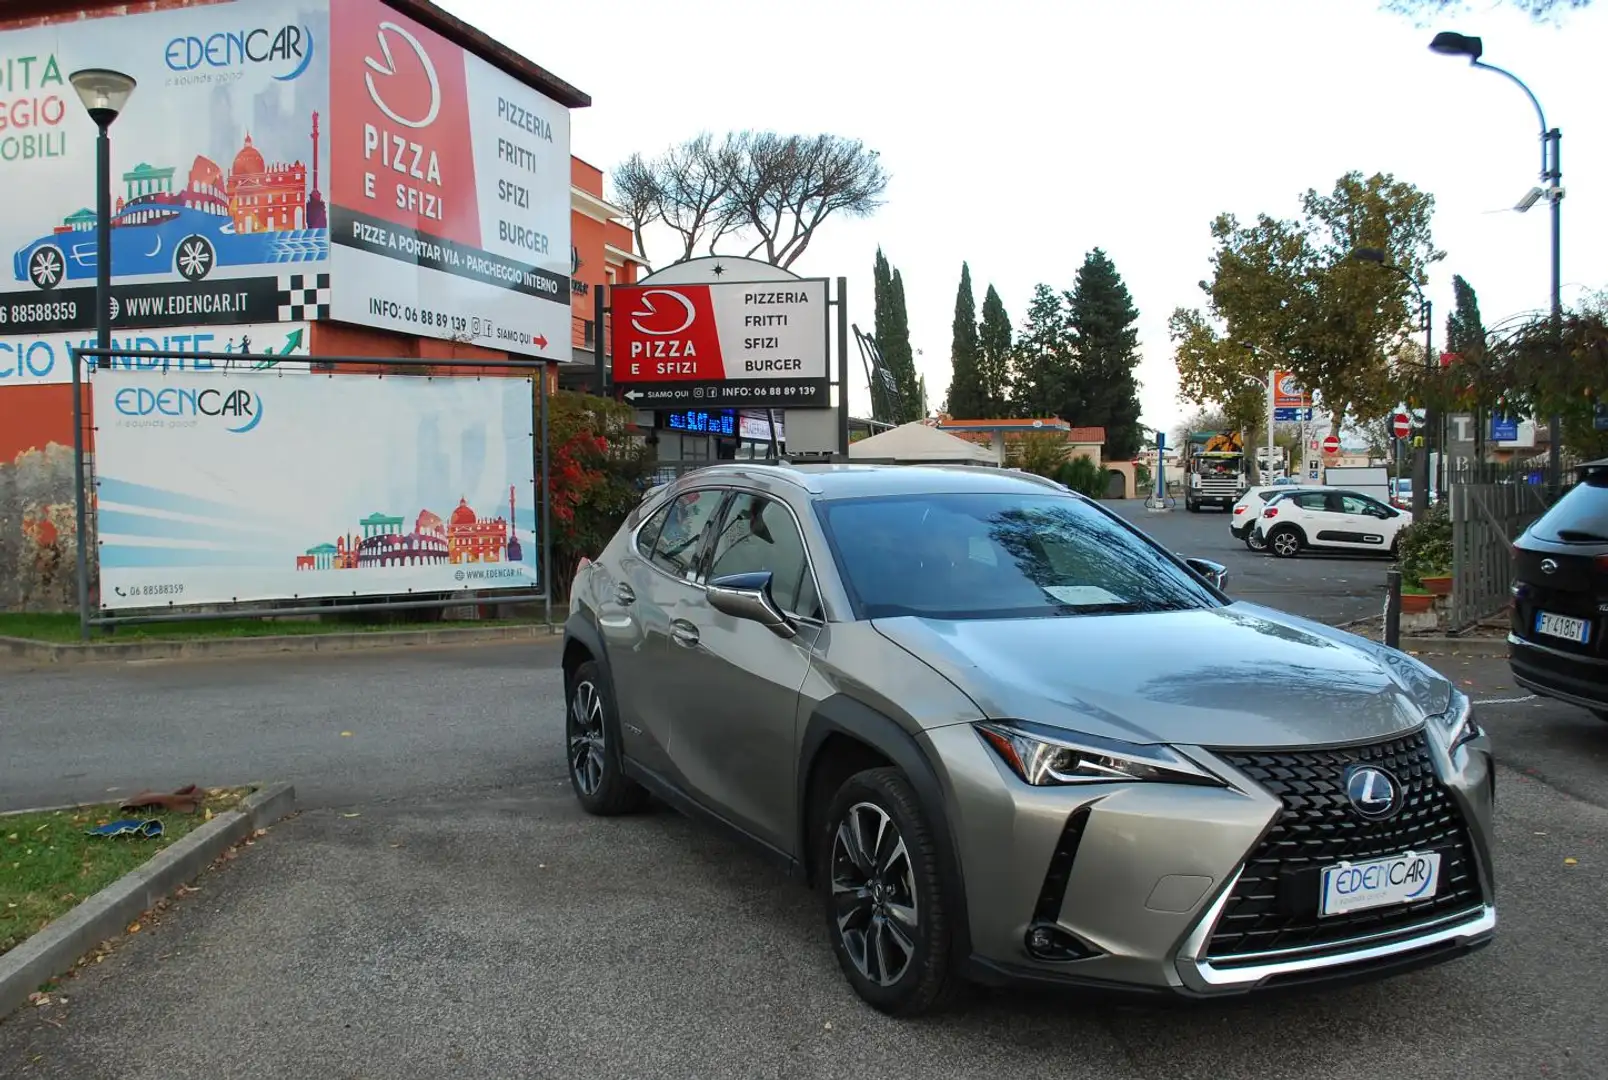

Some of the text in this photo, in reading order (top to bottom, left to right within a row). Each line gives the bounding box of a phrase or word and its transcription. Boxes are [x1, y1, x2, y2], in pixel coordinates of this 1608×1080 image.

[165, 25, 303, 71] EDENCAR
[0, 53, 64, 92] ITA
[498, 97, 553, 143] PIZZERIA
[364, 123, 442, 186] PIZZA
[498, 138, 536, 173] FRITTI
[365, 172, 443, 220] E SFIZI
[498, 179, 529, 209] SFIZI
[499, 220, 549, 255] BURGER
[353, 221, 387, 246] PIZZE
[389, 233, 397, 249] A
[399, 235, 441, 261] PORTAR
[442, 248, 460, 267] VIA
[466, 255, 522, 284] PARCHEGGIO
[523, 273, 558, 294] INTERNO
[12, 302, 77, 322] 88588359
[126, 292, 249, 317] WWW.EDENCAR.IT
[745, 292, 809, 304] PIZZERIA
[369, 297, 531, 345] INFO: 06 88 89 139 SIAMO QUI
[745, 314, 788, 327] FRITTI
[631, 340, 697, 358] PIZZA
[744, 337, 779, 350] SFIZI
[631, 362, 697, 375] E SFIZI
[745, 359, 801, 372] BURGER
[115, 388, 253, 417] EDENCAR
[675, 390, 689, 398] QUI
[722, 387, 752, 396] INFO:
[754, 387, 767, 396] 06
[769, 387, 781, 396] 88
[784, 387, 796, 396] 89
[799, 386, 816, 396] 139
[130, 584, 184, 596] 06 88588359
[1336, 858, 1425, 894] EDENCAR
